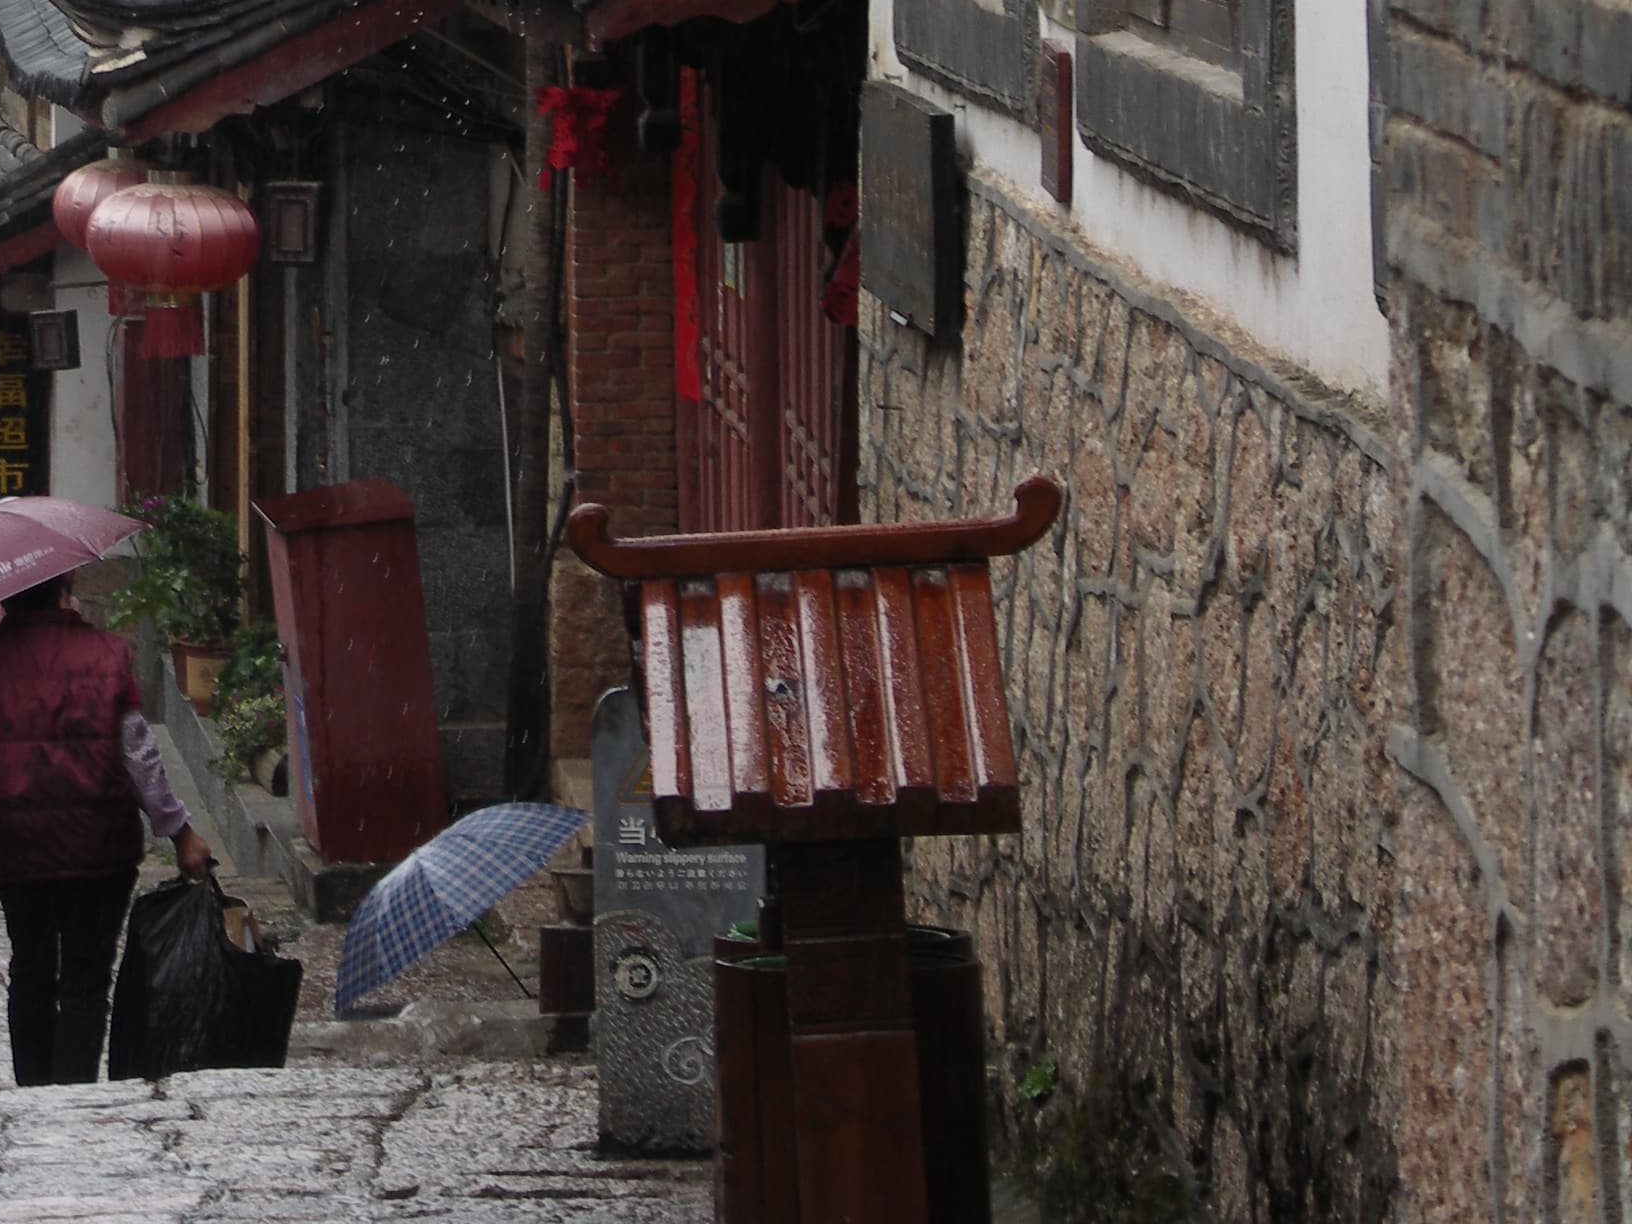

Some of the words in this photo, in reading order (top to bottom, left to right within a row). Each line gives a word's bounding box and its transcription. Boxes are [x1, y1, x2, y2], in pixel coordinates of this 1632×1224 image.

[615, 852, 662, 866] Warning
[663, 852, 706, 866] slippery
[707, 851, 747, 864] surface
